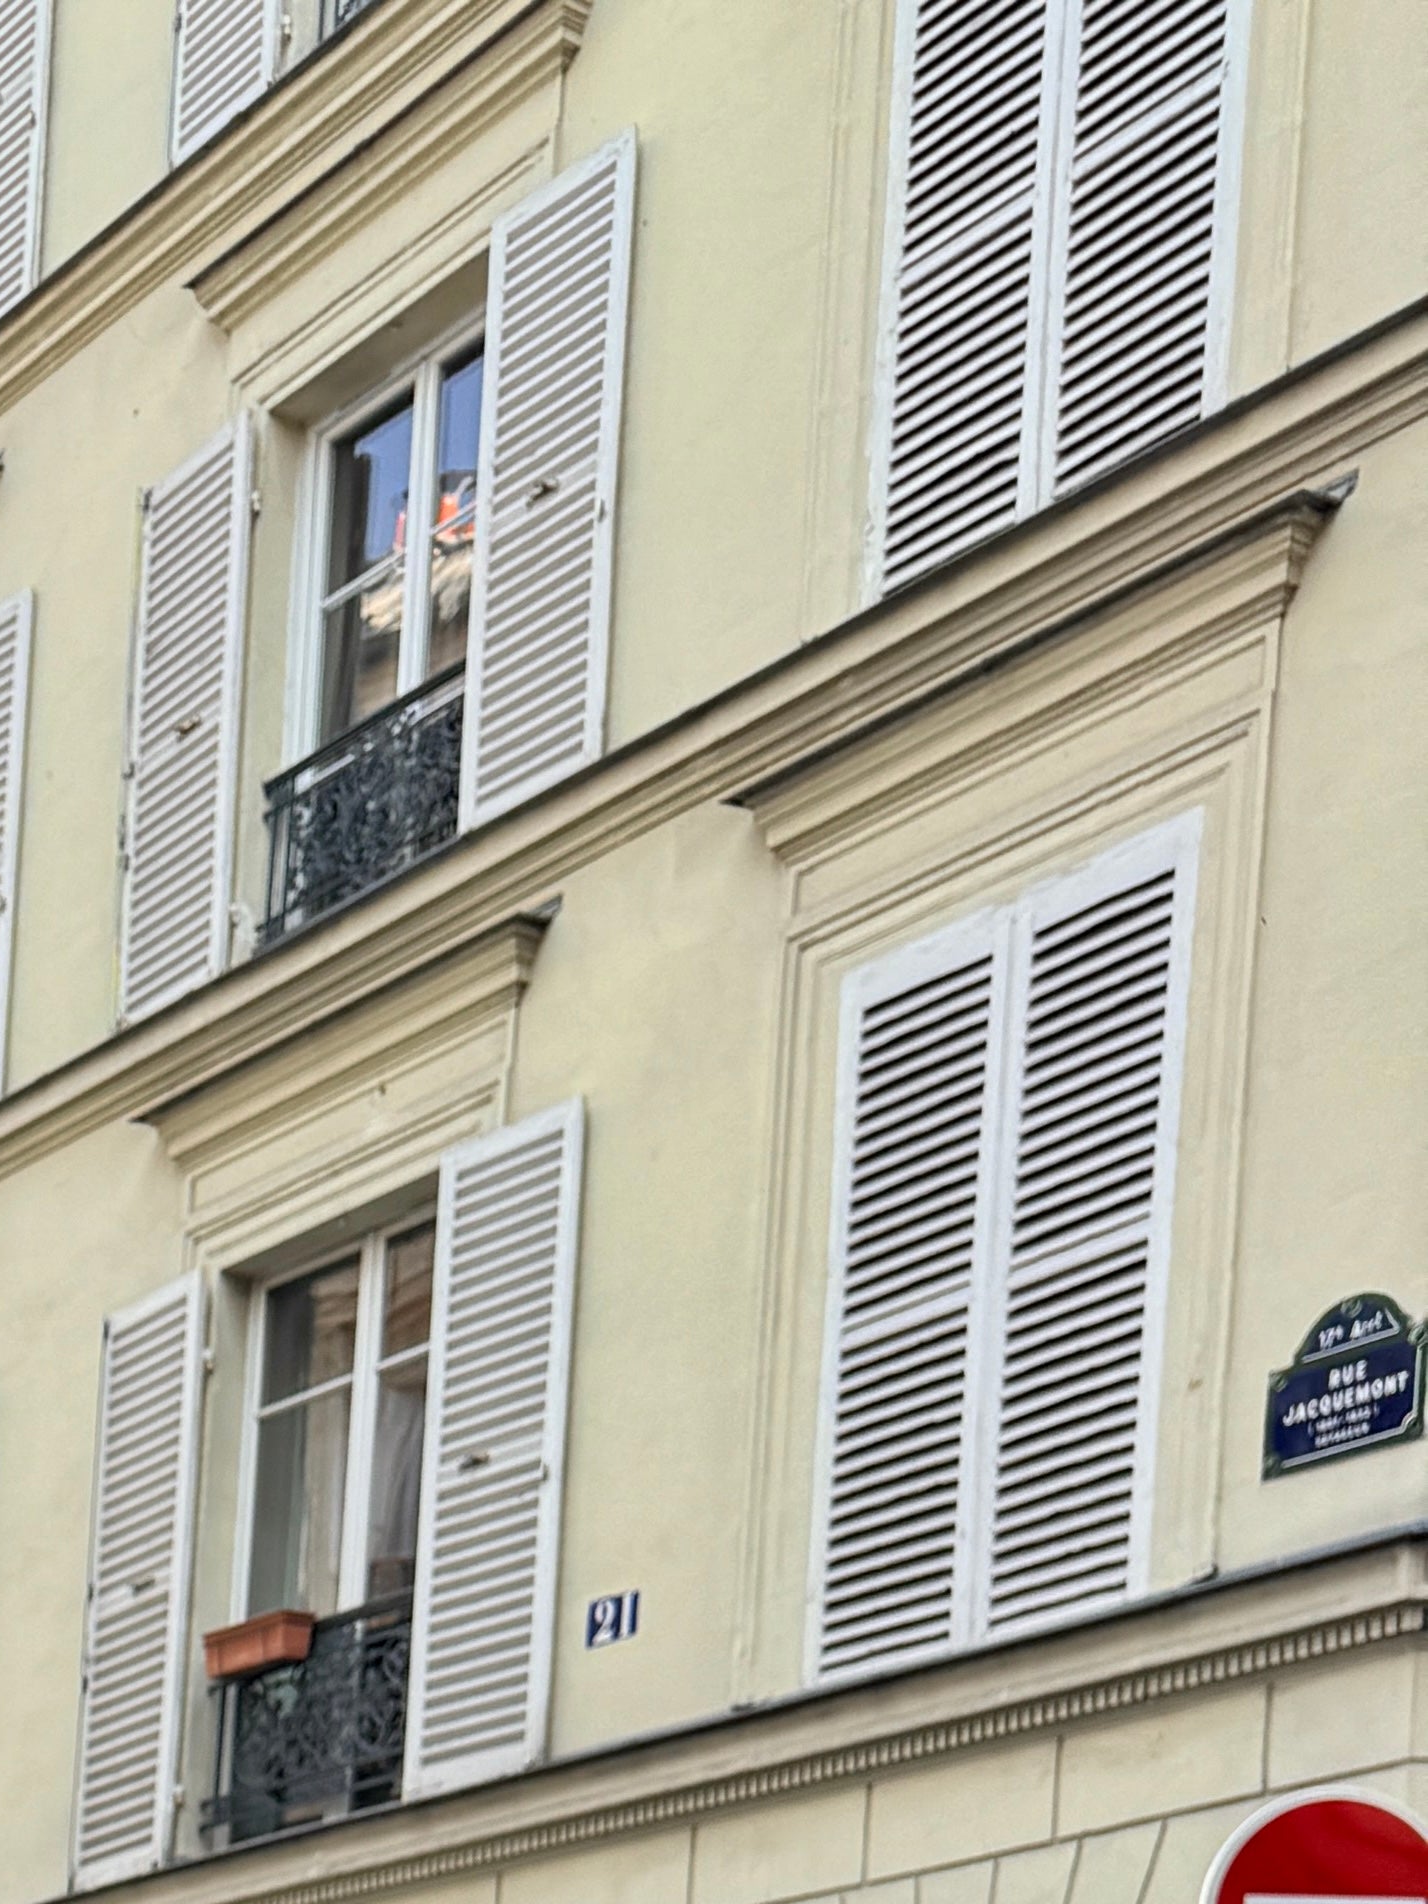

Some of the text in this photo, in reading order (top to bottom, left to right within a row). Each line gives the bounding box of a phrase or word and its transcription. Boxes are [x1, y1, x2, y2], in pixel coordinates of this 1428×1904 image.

[1282, 1370, 1410, 1427] JACQUEMONT
[1328, 1359, 1368, 1391] RUE
[591, 1591, 633, 1643] 21
